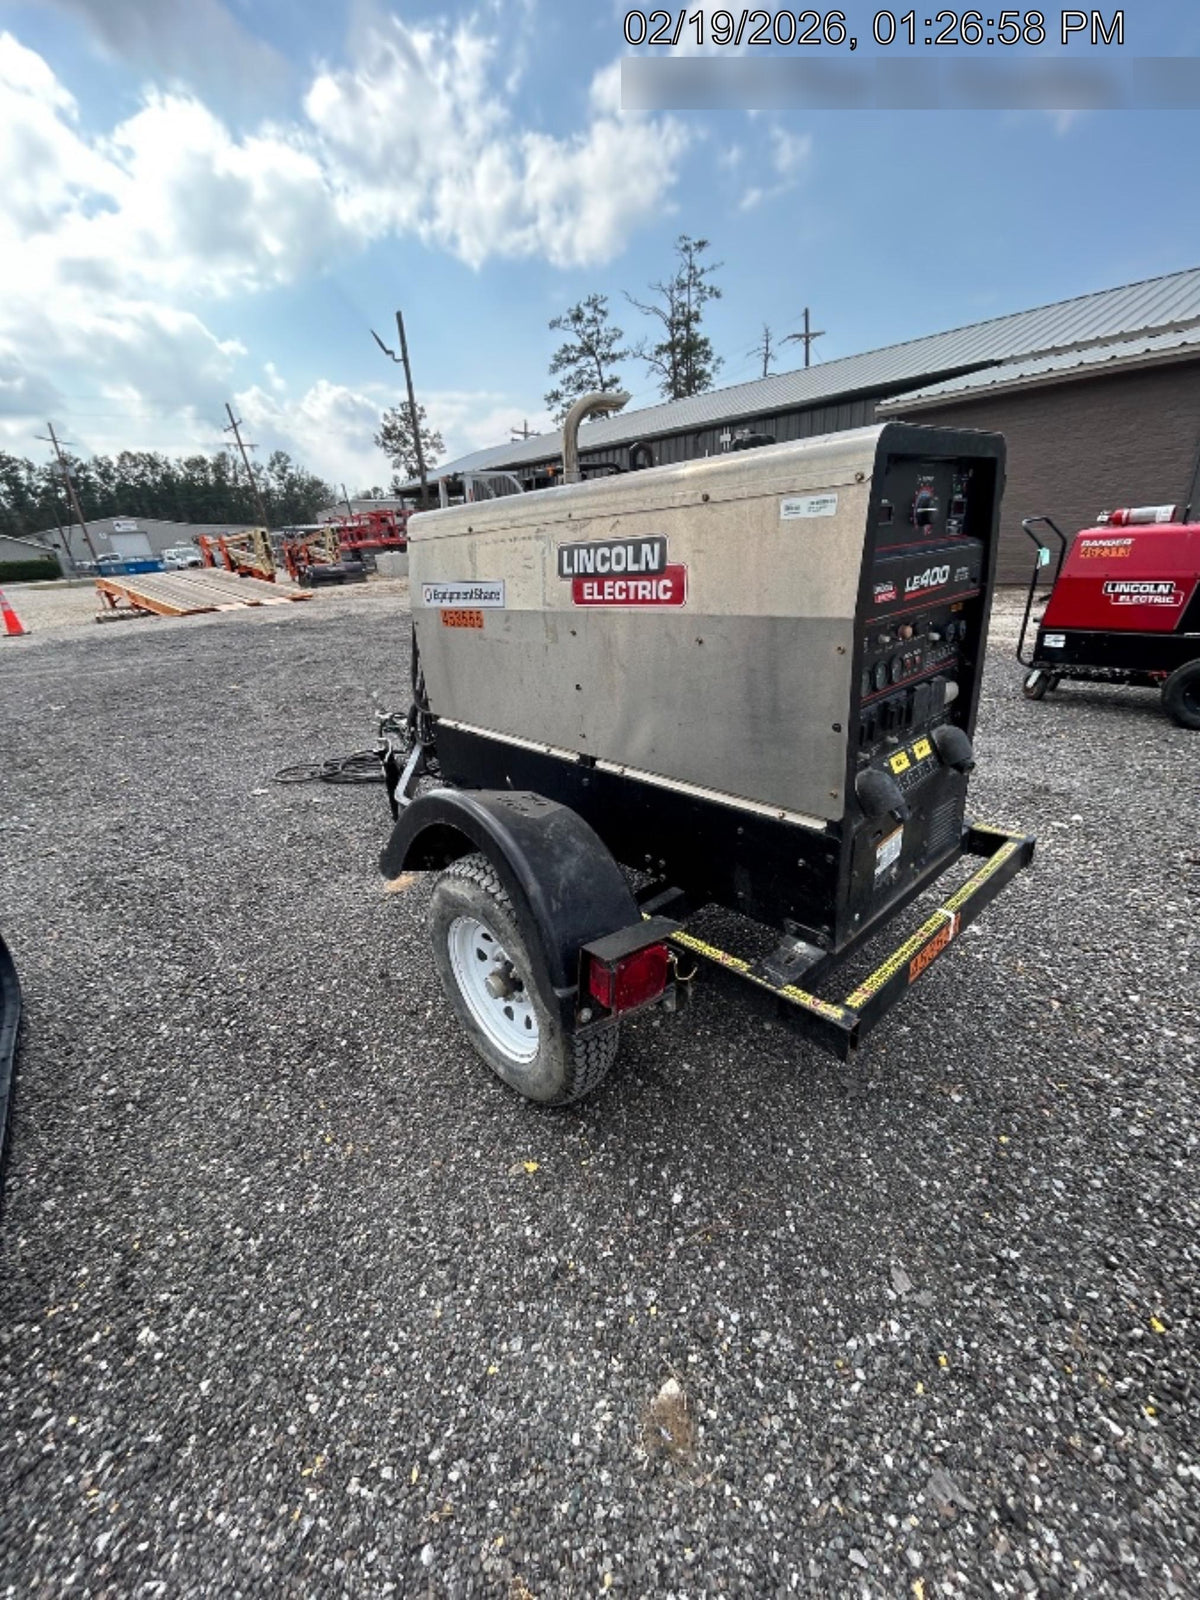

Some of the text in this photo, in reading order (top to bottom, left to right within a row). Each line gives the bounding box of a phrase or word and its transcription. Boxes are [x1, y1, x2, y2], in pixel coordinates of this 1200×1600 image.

[562, 542, 660, 575] LINCOLN
[904, 564, 950, 593] LE400
[433, 587, 500, 603] EquipmentShare
[582, 579, 673, 601] ELECTRIC
[1106, 583, 1171, 594] LINCOLN
[1118, 595, 1174, 604] ELECTRIC
